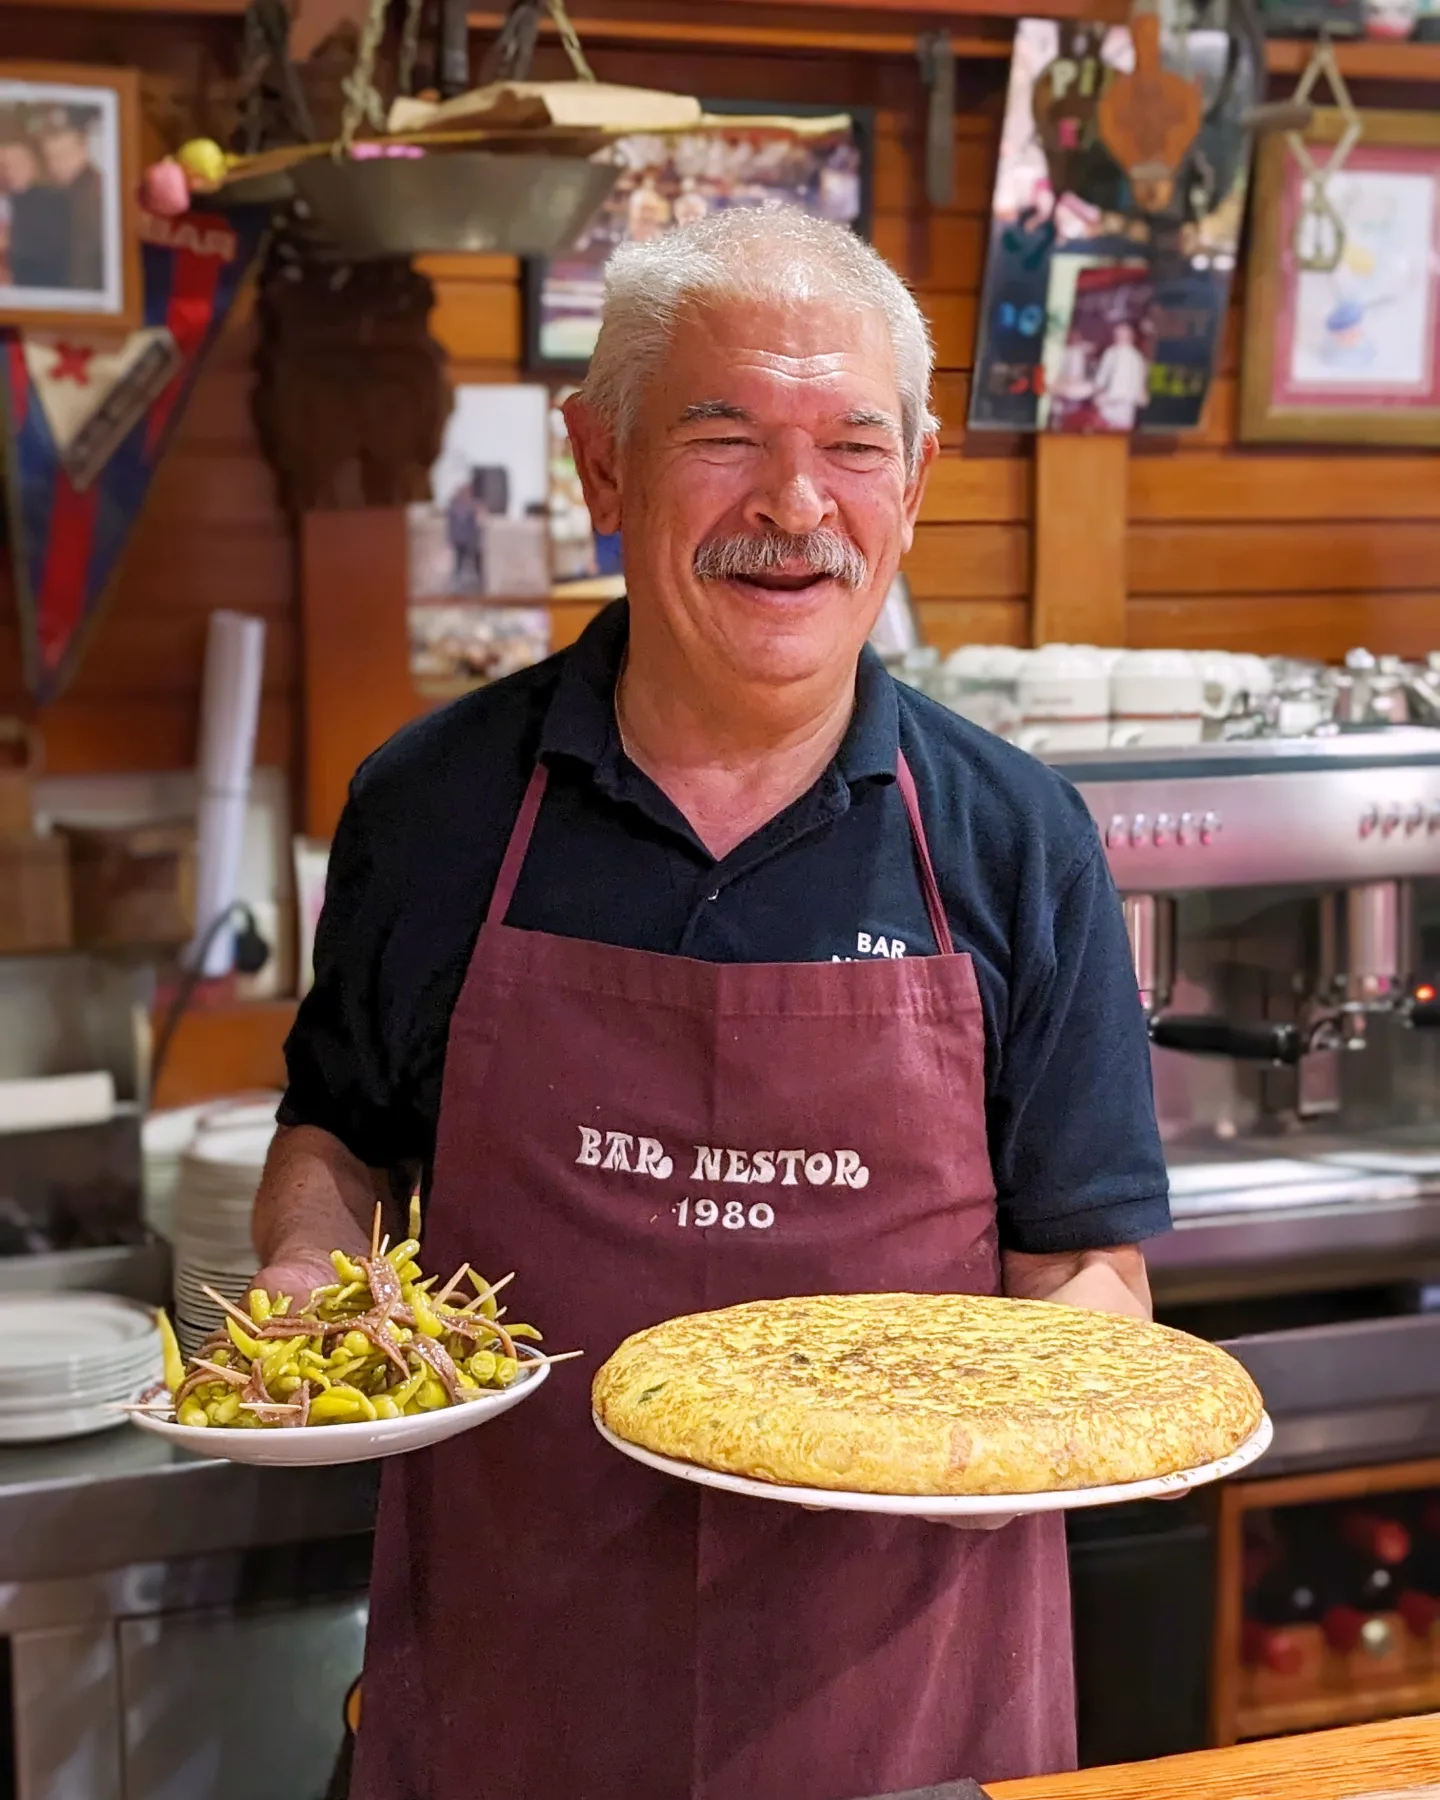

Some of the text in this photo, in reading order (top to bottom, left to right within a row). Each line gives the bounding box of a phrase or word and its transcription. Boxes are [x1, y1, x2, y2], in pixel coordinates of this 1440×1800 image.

[857, 932, 906, 960] BAR
[574, 1125, 870, 1189] BAR NESTOR
[676, 1197, 775, 1230] 1980
